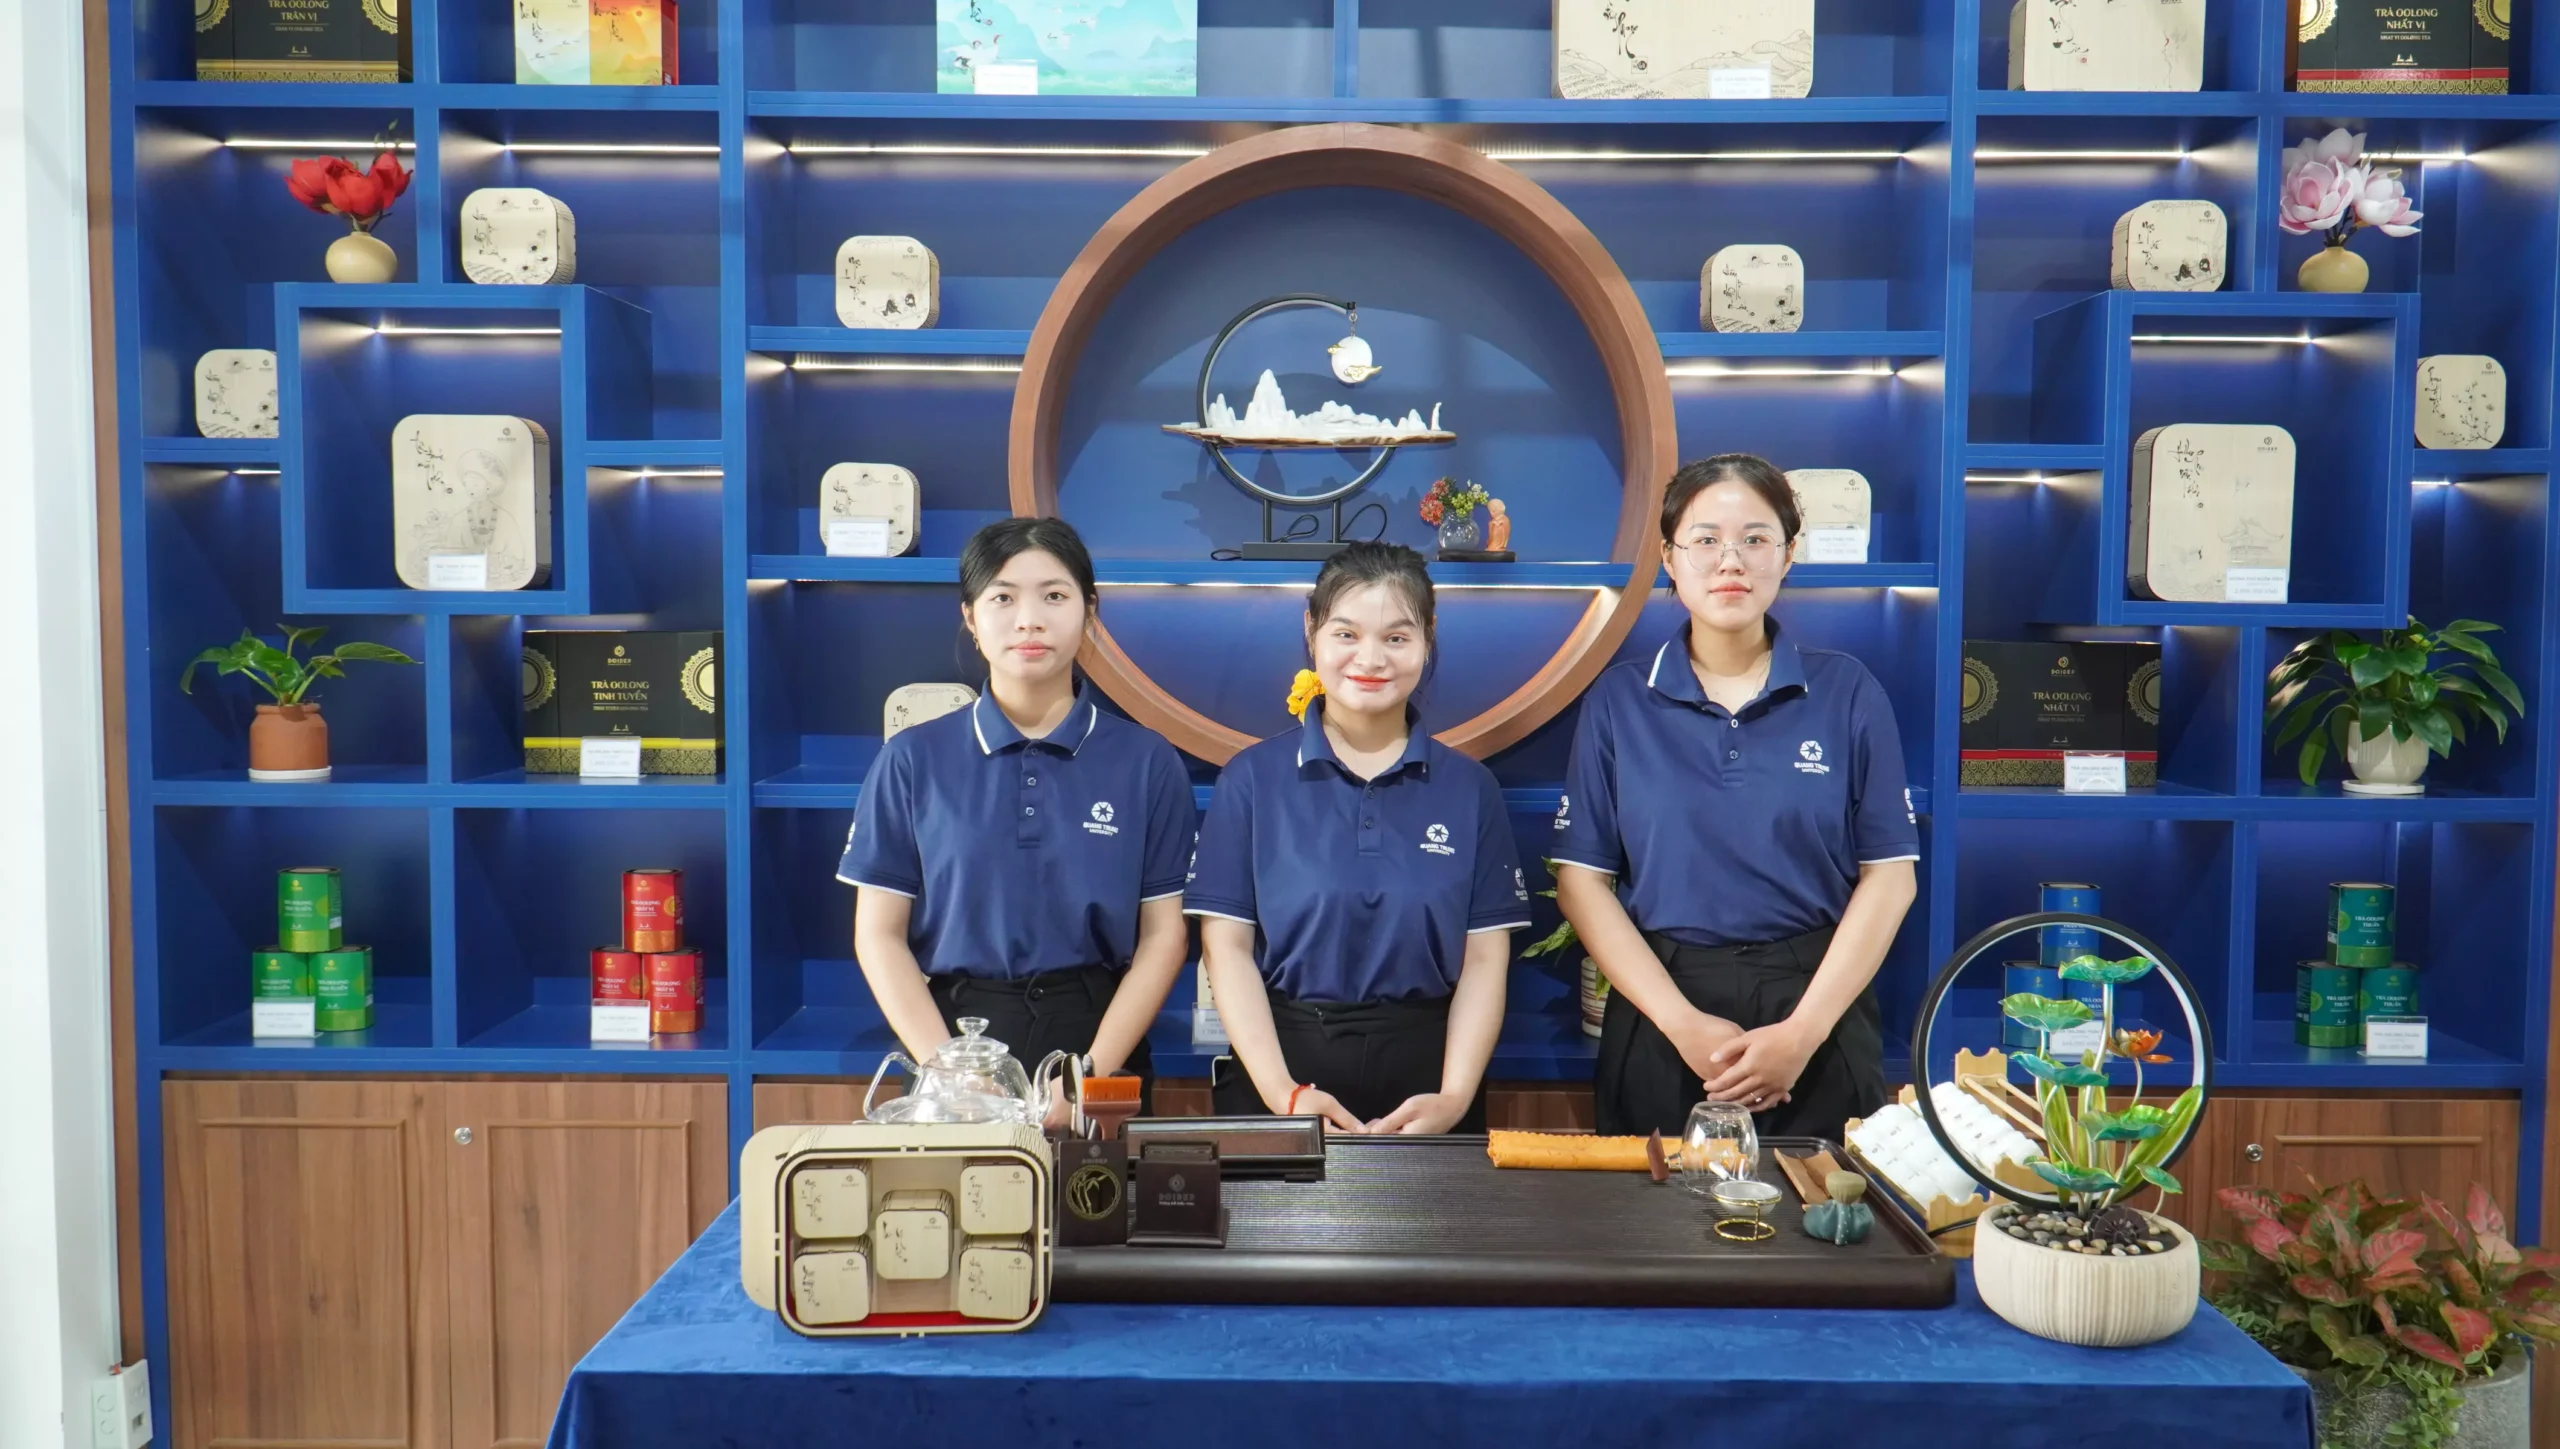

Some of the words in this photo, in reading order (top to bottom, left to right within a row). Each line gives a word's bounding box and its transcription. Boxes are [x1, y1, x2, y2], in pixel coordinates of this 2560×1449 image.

[2396, 8, 2438, 17] OOLONG
[2386, 18, 2413, 29] NHẤT
[2416, 20, 2425, 30] VỊ
[610, 681, 649, 689] OOLONG
[593, 692, 615, 700] TINH
[2052, 693, 2092, 701] OOLONG
